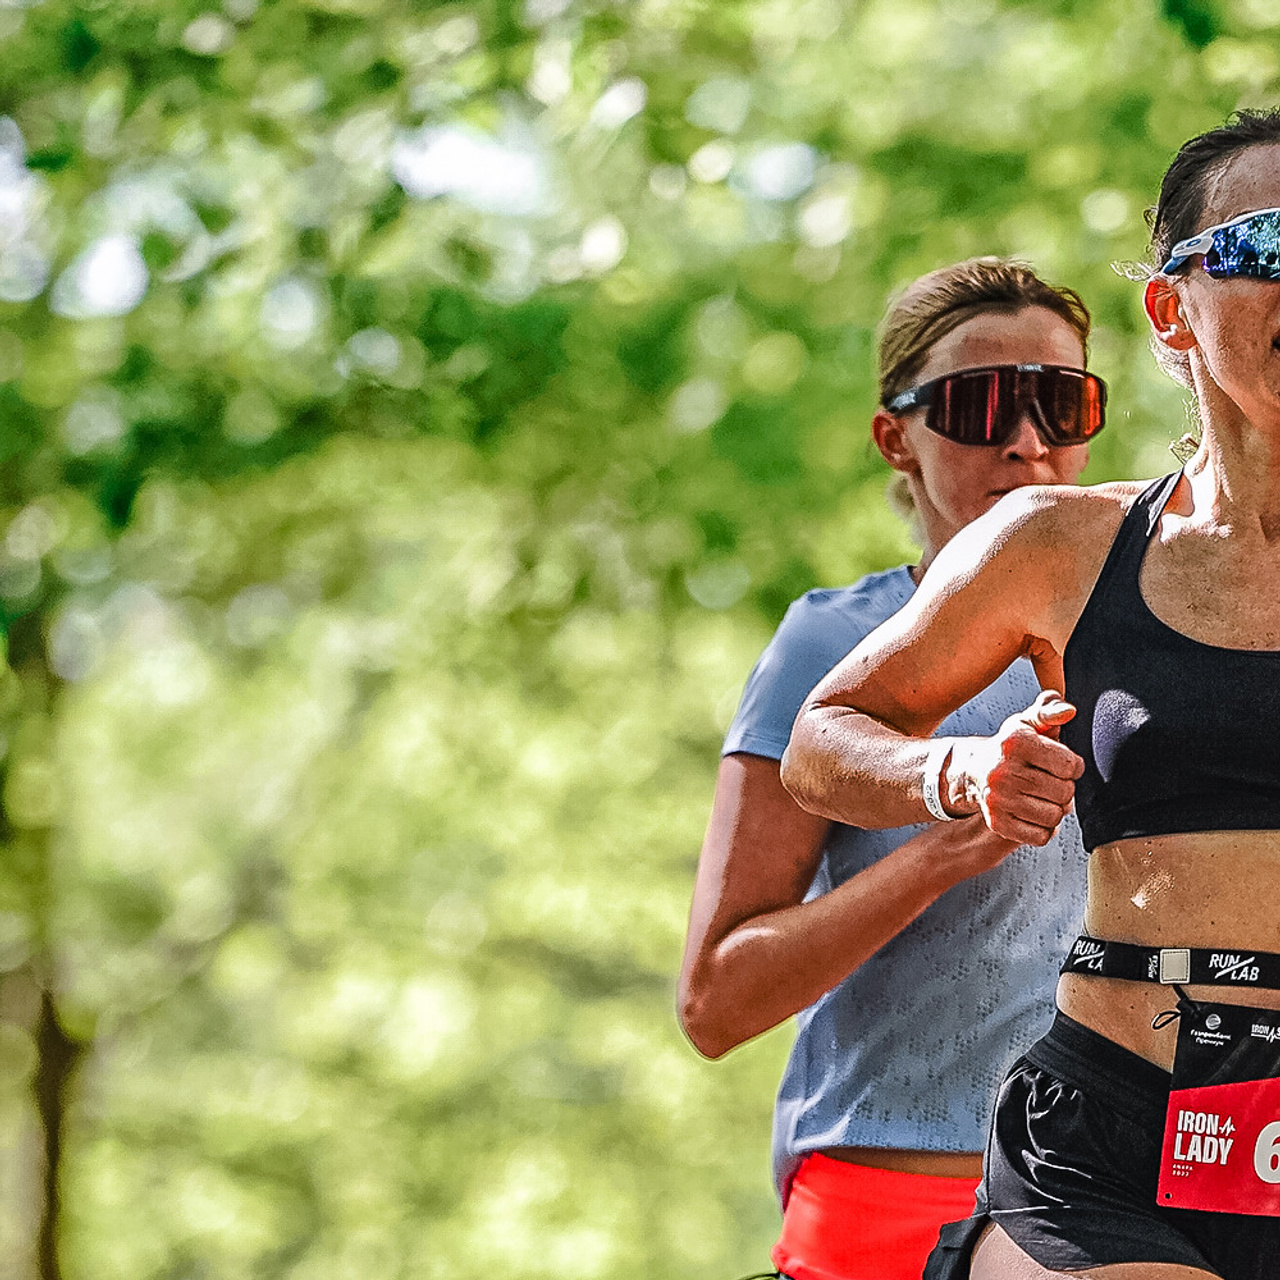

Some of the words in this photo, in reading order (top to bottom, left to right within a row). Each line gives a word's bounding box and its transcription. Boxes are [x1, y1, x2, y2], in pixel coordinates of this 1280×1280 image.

[1072, 939, 1101, 955] RUN
[1087, 958, 1104, 971] LA
[1208, 953, 1240, 968] RUN
[1230, 966, 1260, 981] LAB
[1251, 1023, 1270, 1034] IRON
[1177, 1109, 1219, 1135] IRON
[1173, 1132, 1234, 1166] LADY
